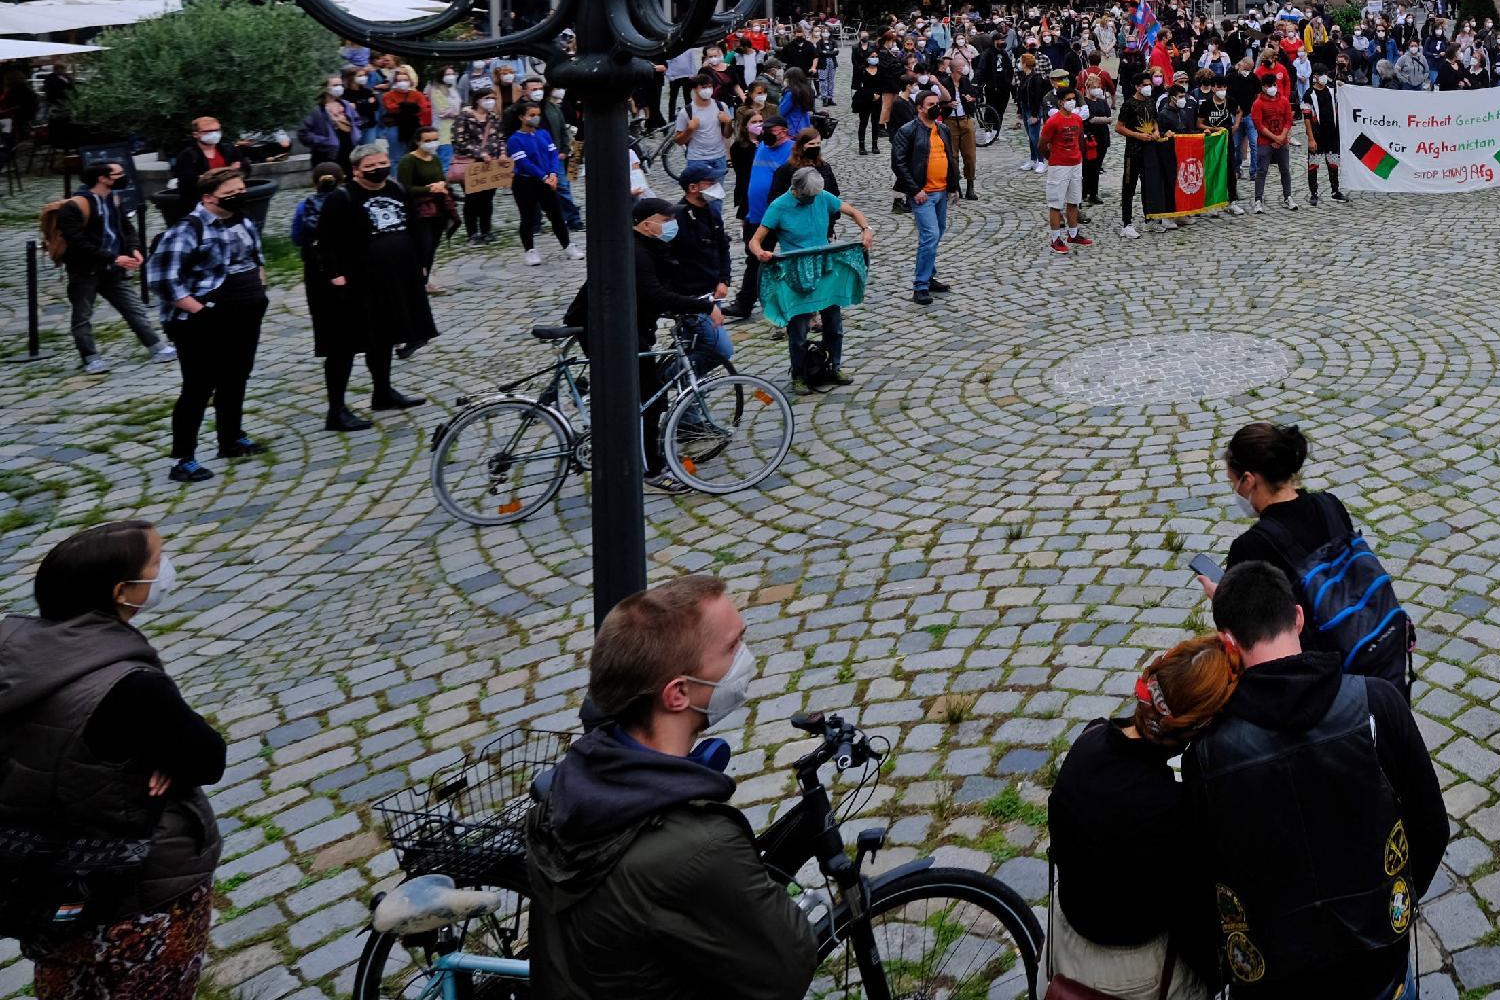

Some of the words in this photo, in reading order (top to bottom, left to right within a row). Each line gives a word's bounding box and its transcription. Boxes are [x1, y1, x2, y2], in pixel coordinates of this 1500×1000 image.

[1407, 114, 1452, 127] Freiheit
[1388, 141, 1407, 152] für
[1416, 138, 1495, 158] Afghanistan
[1414, 169, 1439, 180] STOP
